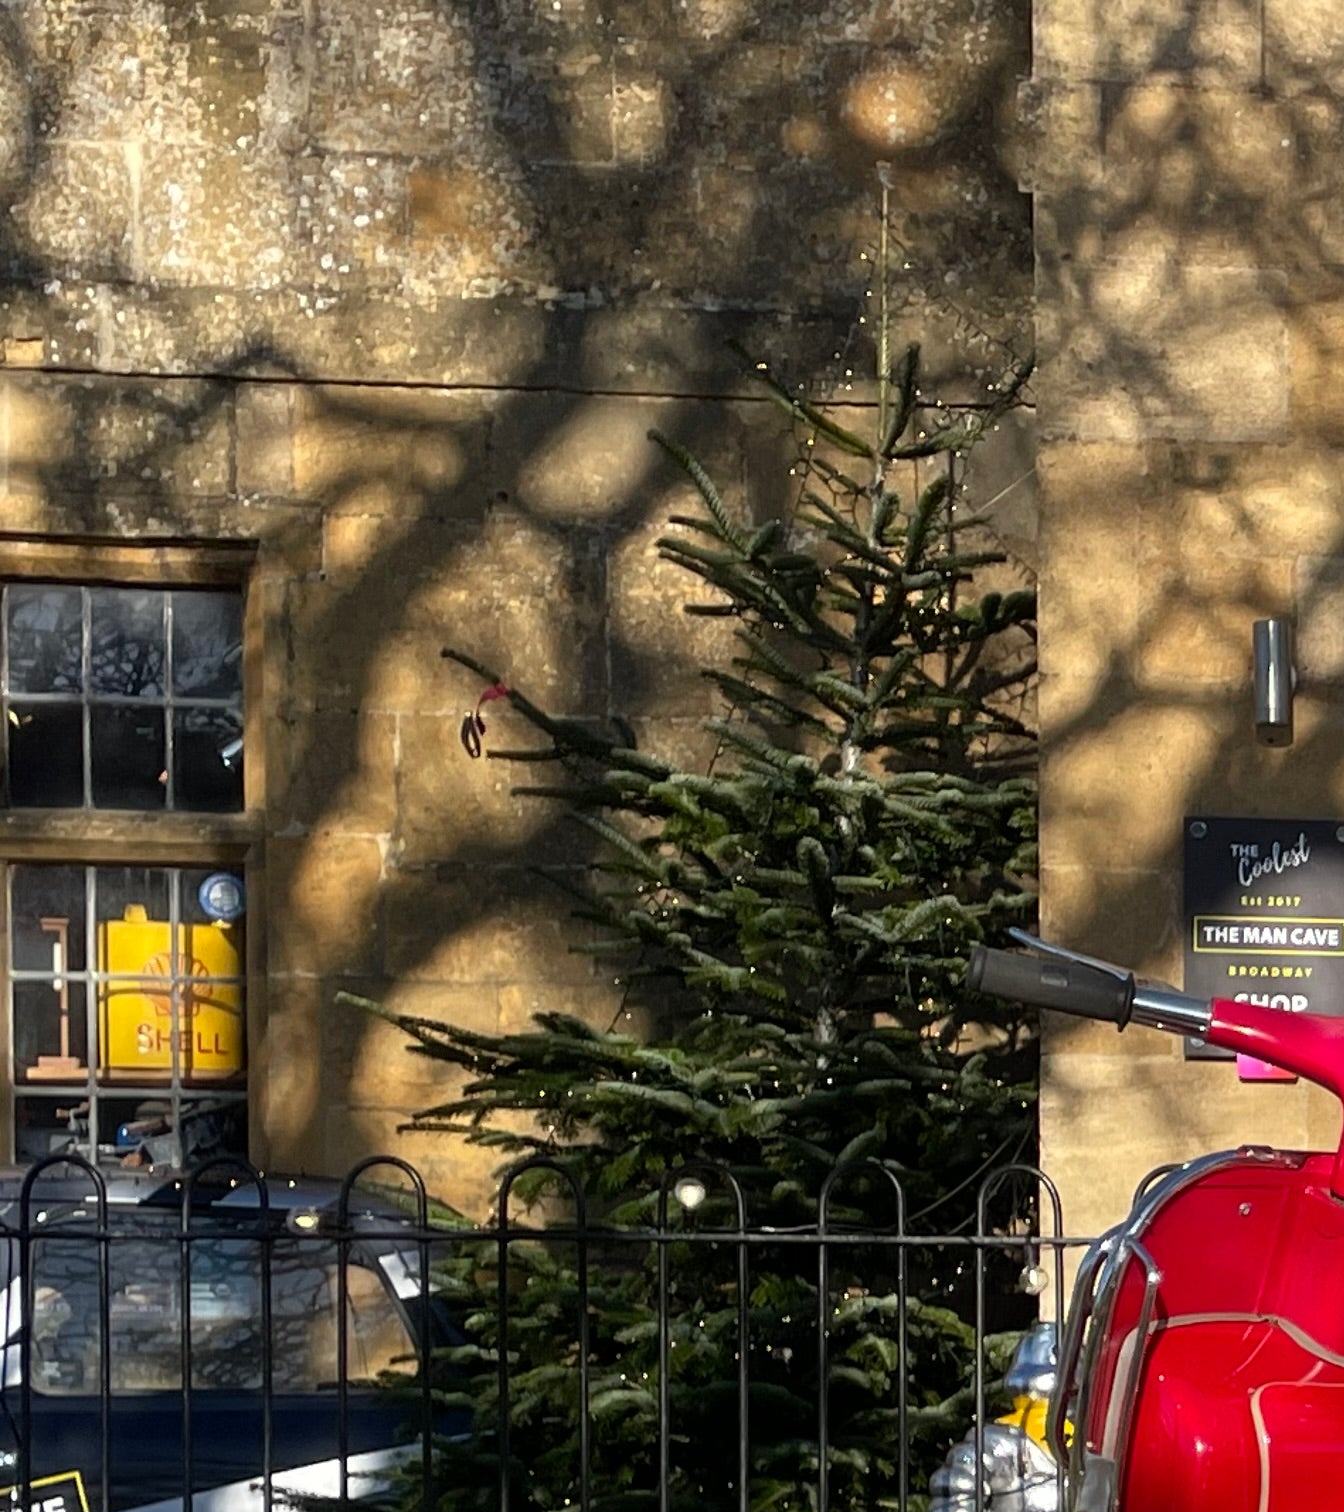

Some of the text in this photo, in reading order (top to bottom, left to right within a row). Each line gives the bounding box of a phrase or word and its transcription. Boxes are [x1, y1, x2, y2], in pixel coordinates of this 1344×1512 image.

[1230, 833, 1311, 887] THE Coolest
[1267, 896, 1301, 907] 2017
[1203, 926, 1339, 947] THE MAN CAVE
[1227, 965, 1313, 978] BROADWAY
[137, 1023, 230, 1055] SHELL
